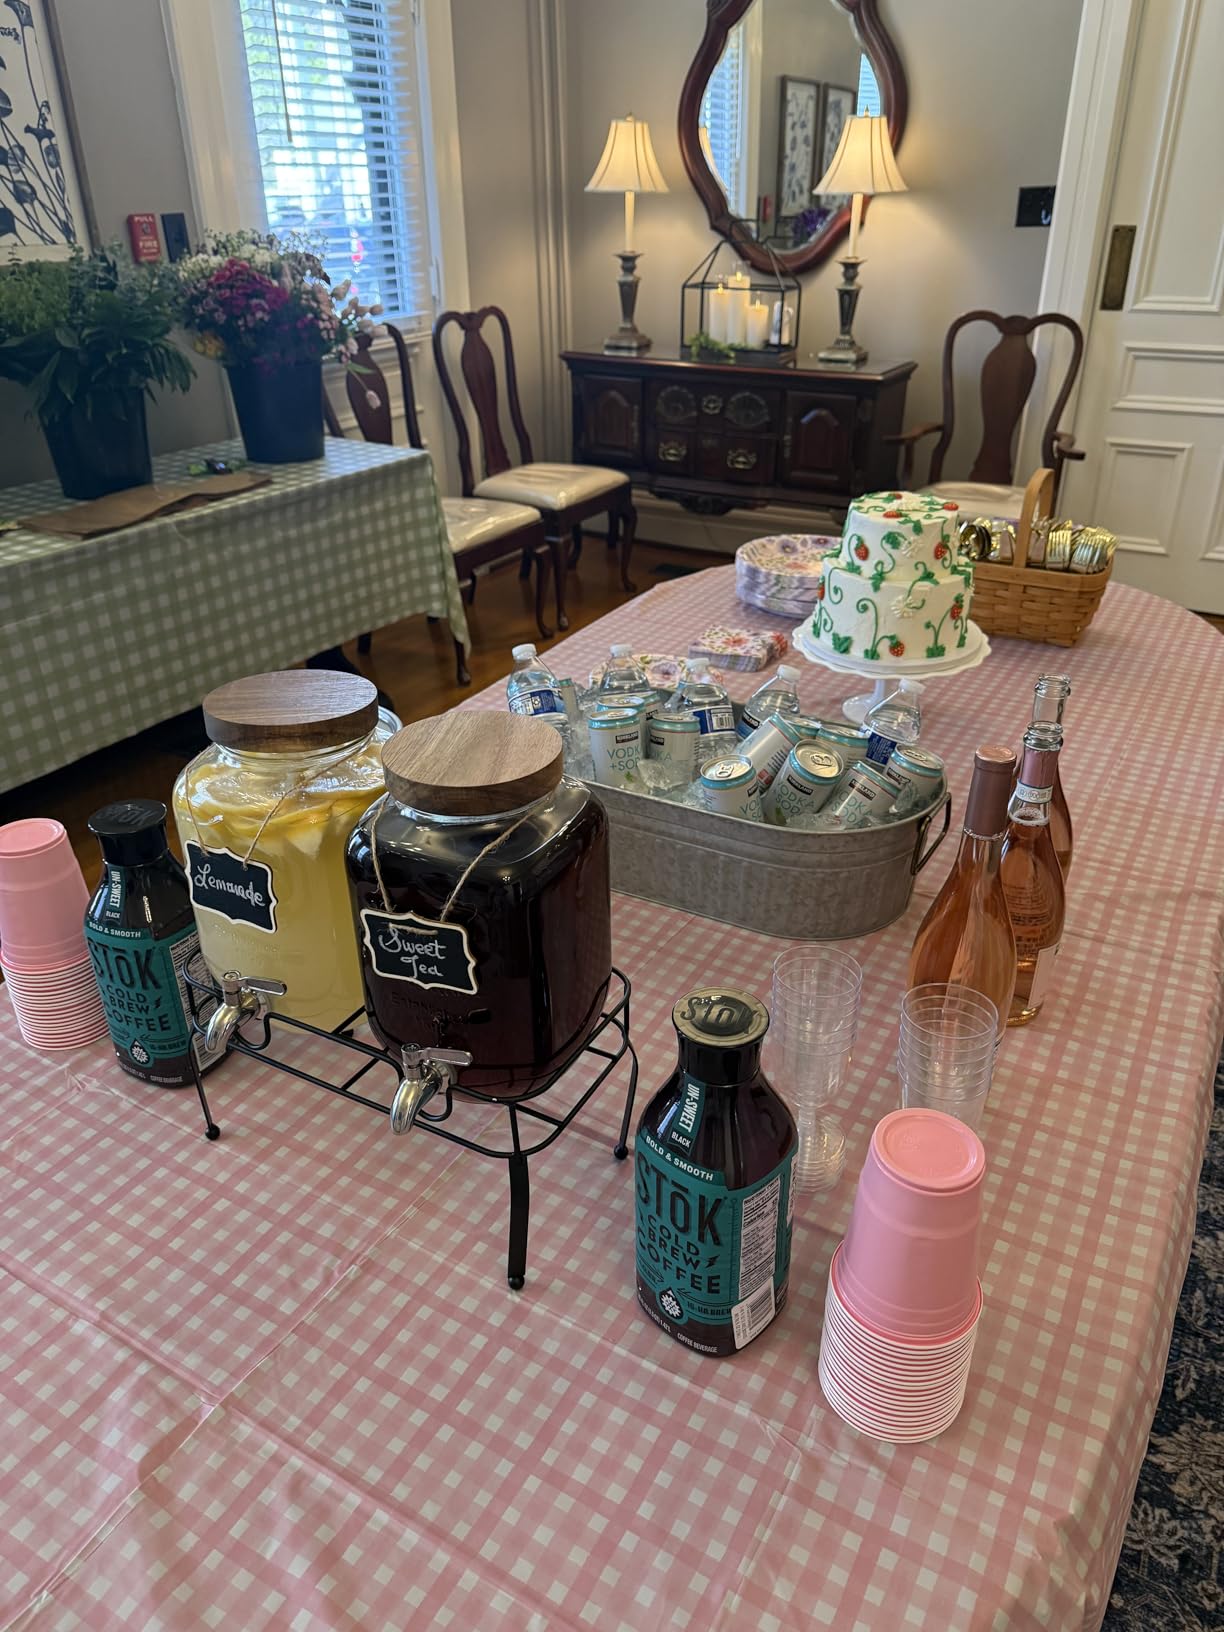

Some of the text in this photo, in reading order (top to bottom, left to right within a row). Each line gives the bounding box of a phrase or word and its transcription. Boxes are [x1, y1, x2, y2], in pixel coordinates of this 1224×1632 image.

[607, 745, 640, 760] VODK
[776, 794, 802, 816] SOD
[838, 790, 872, 815] ODKA
[109, 870, 121, 908] UN-SWEET
[105, 910, 120, 919] BLACK
[89, 921, 104, 933] BOLD
[111, 929, 141, 938] SMOOTH
[378, 926, 446, 959] Sweet
[400, 955, 443, 979] Tea
[106, 984, 147, 1003] COLD
[109, 995, 149, 1014] BREW
[679, 1084, 700, 1132] UN-SWEET
[671, 1131, 691, 1148] BLACK
[646, 1136, 714, 1181] BOLD & SMOOTH
[647, 1214, 700, 1256] COLD
[637, 1226, 721, 1294] COFFEE
[648, 1227, 700, 1270] BREW
[677, 1332, 718, 1353] COFFEE BEVERAGE
